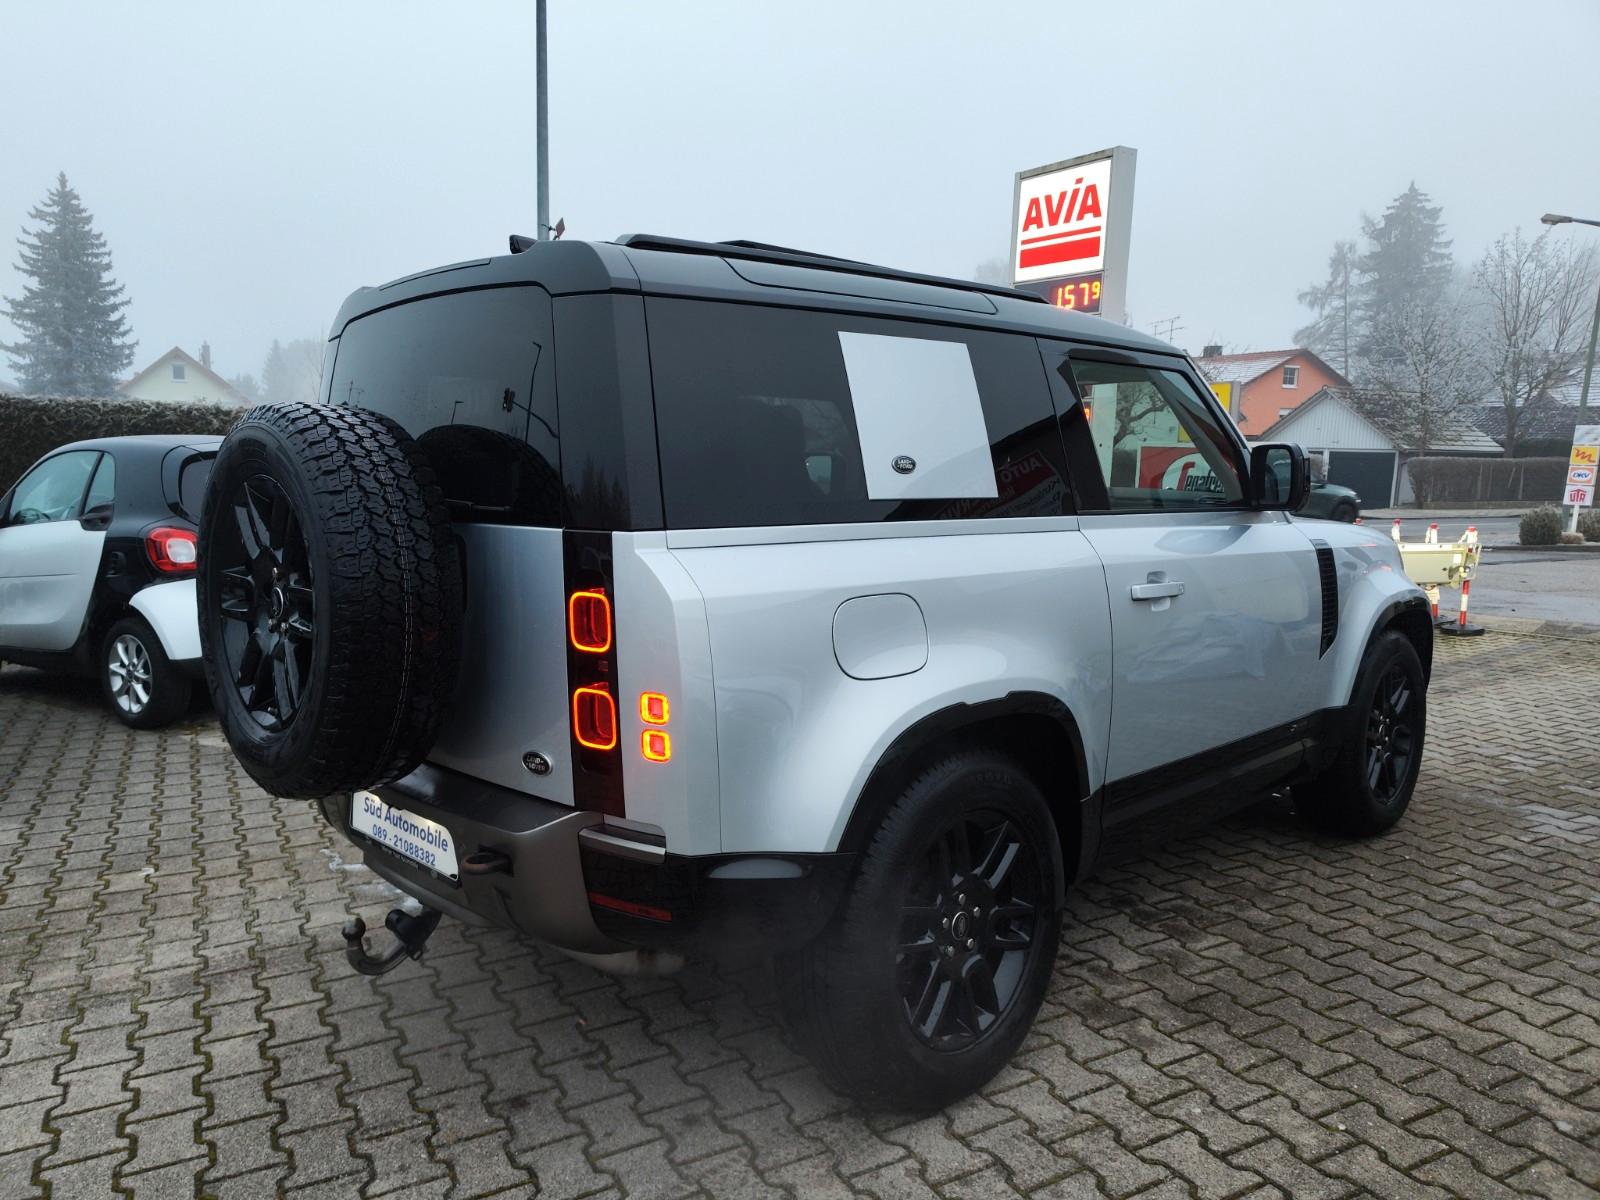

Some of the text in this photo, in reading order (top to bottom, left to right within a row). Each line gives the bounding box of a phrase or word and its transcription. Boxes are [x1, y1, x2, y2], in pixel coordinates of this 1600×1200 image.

[1022, 177, 1102, 232] AVIA
[1572, 471, 1590, 479] DKV
[363, 797, 448, 852] Süd Automobile
